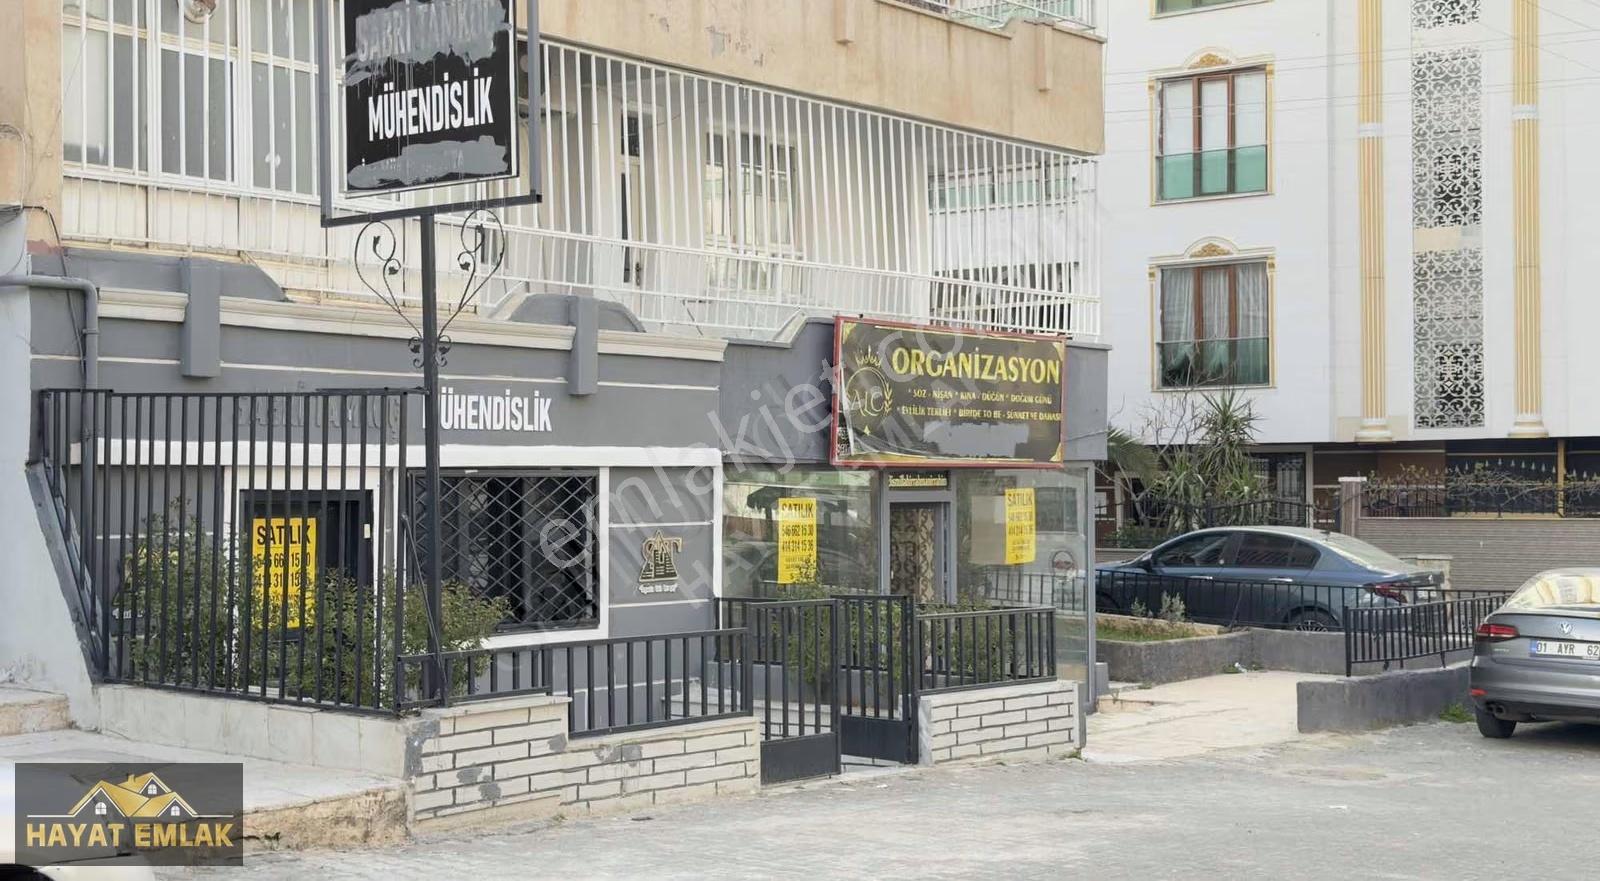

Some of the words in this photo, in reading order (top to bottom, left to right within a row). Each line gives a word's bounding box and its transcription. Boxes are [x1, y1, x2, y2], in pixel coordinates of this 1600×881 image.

[368, 67, 494, 142] MÜHENDİSLİK
[891, 347, 1060, 385] ORGANİZASYON
[781, 503, 814, 518] SATILIK
[257, 525, 311, 545] SATLIK
[291, 553, 301, 568] 15
[1536, 642, 1547, 653] 01
[1557, 643, 1575, 654] AYR
